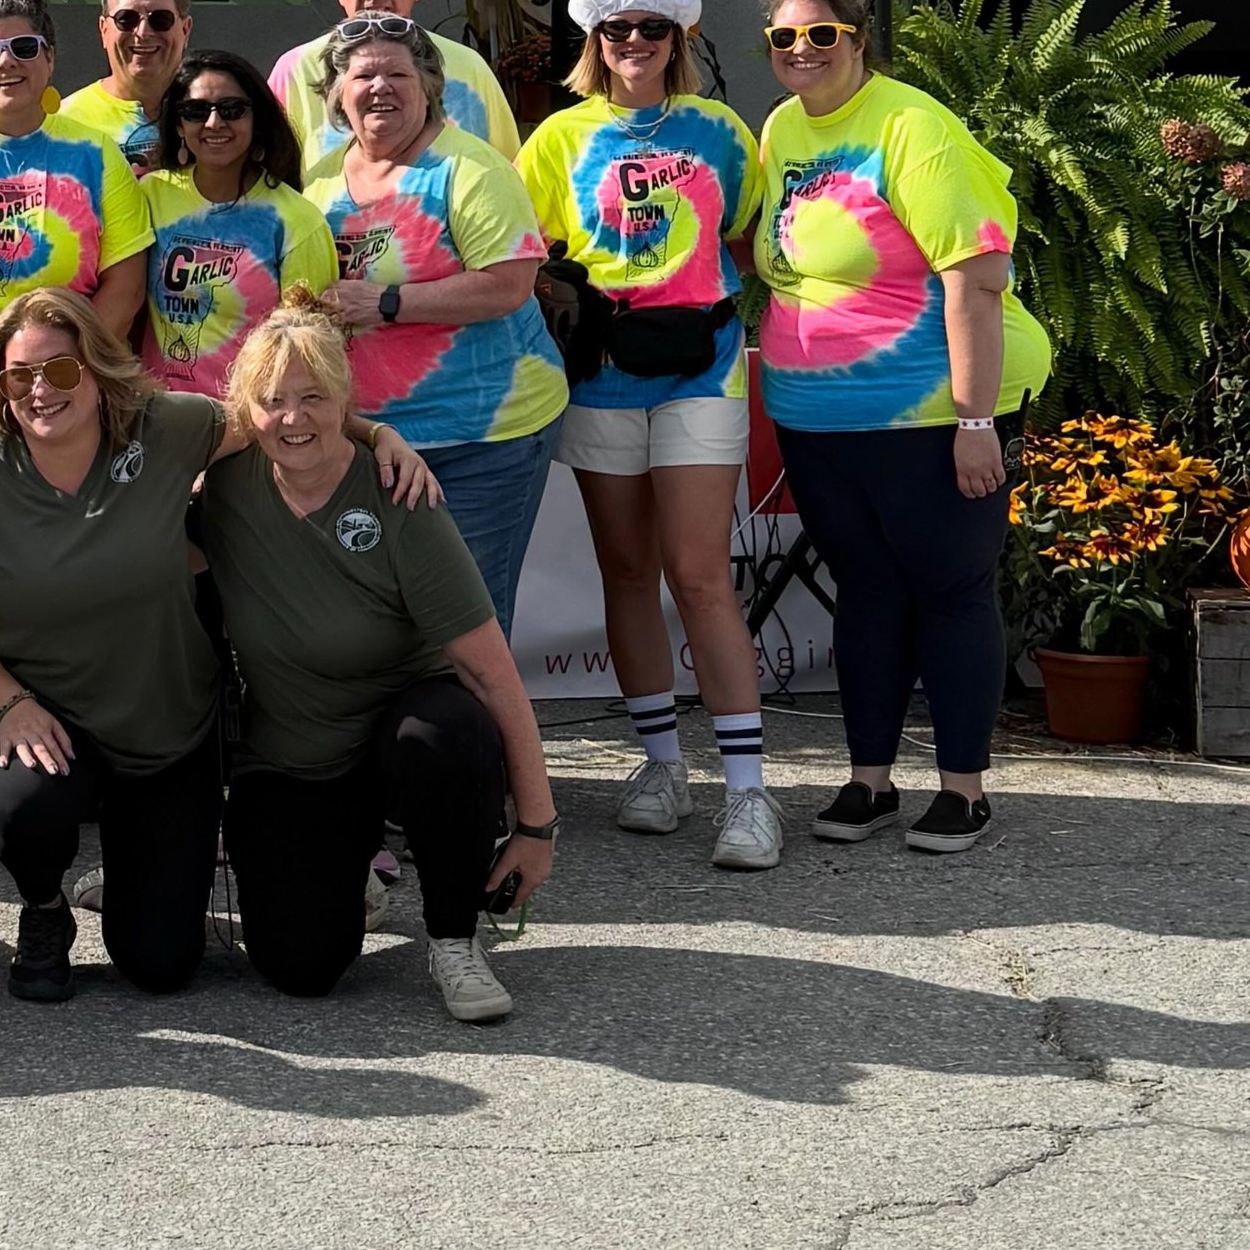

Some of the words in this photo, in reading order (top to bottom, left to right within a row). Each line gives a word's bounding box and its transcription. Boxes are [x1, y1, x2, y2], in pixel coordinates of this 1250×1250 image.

[619, 158, 692, 202] GARLIC
[627, 204, 666, 223] TOWN
[163, 246, 235, 292] GARLIC
[163, 295, 200, 315] TOWN
